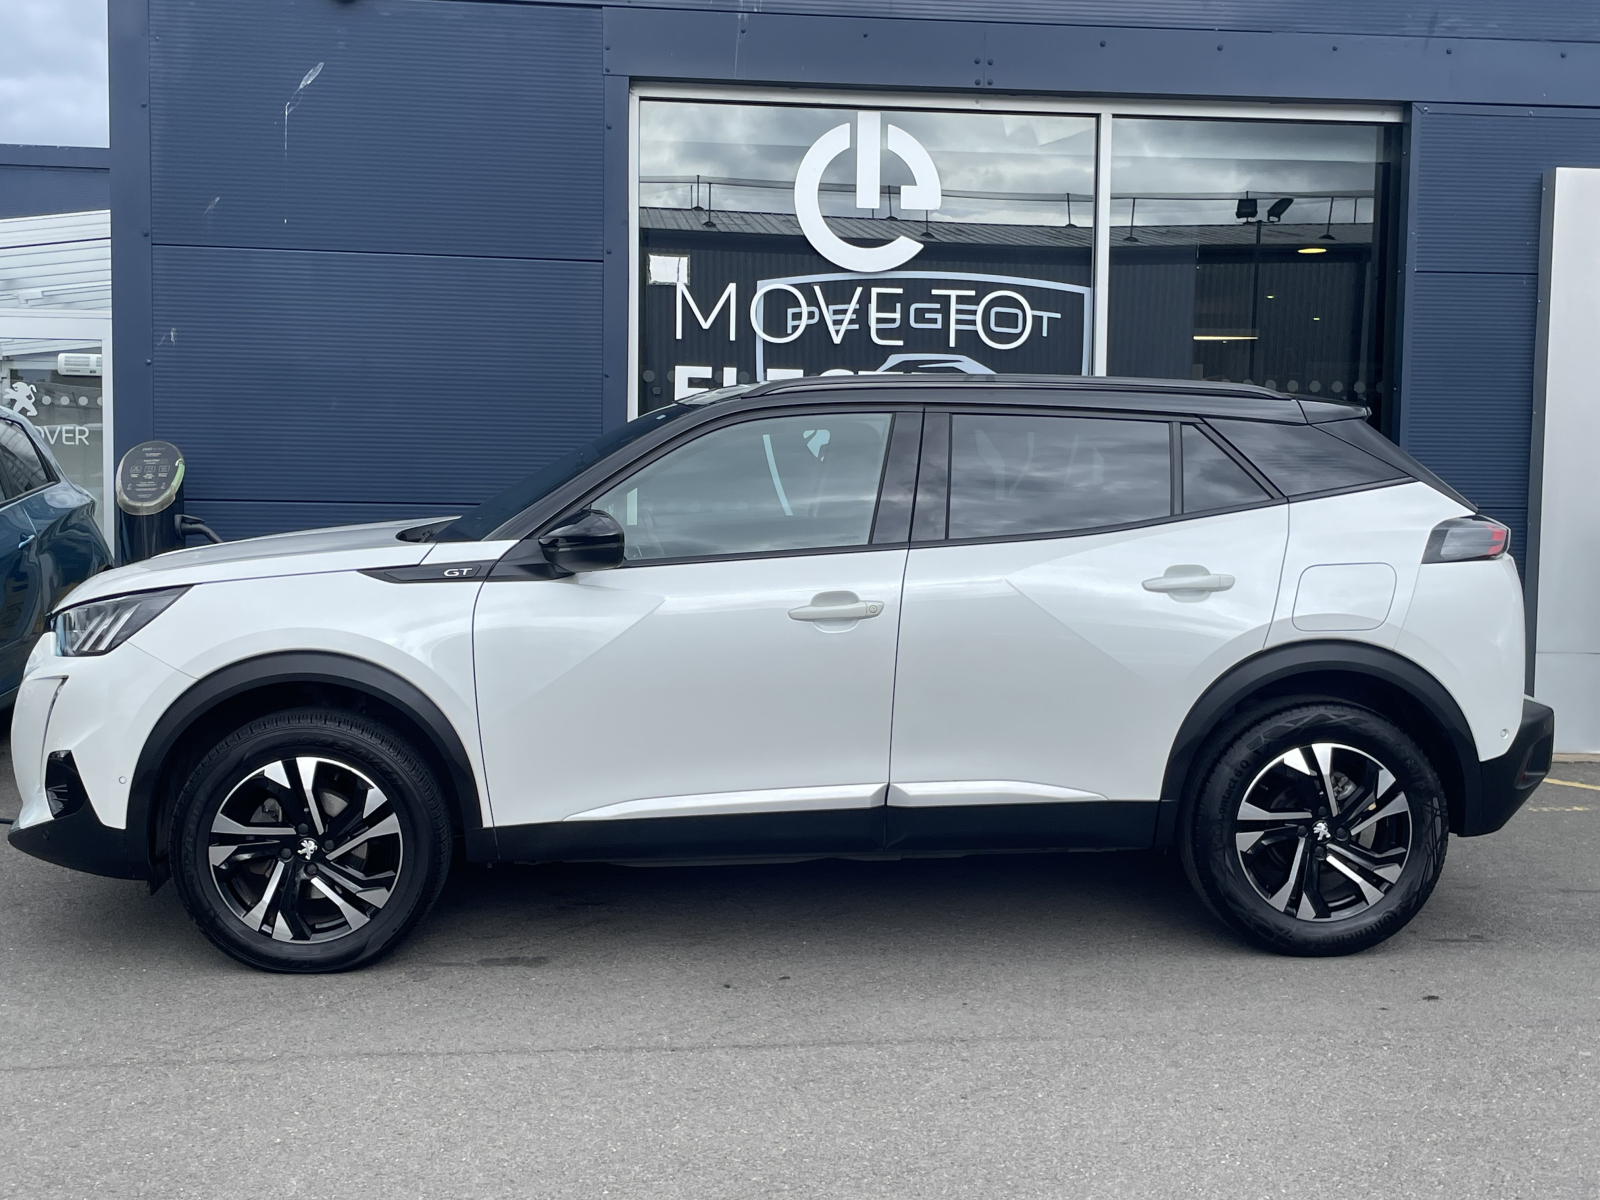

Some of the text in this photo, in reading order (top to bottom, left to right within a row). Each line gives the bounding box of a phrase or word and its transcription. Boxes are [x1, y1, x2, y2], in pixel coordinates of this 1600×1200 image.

[675, 282, 1033, 350] MOVE TO
[786, 301, 1062, 337] PEUGEOT
[443, 567, 473, 577] GT
